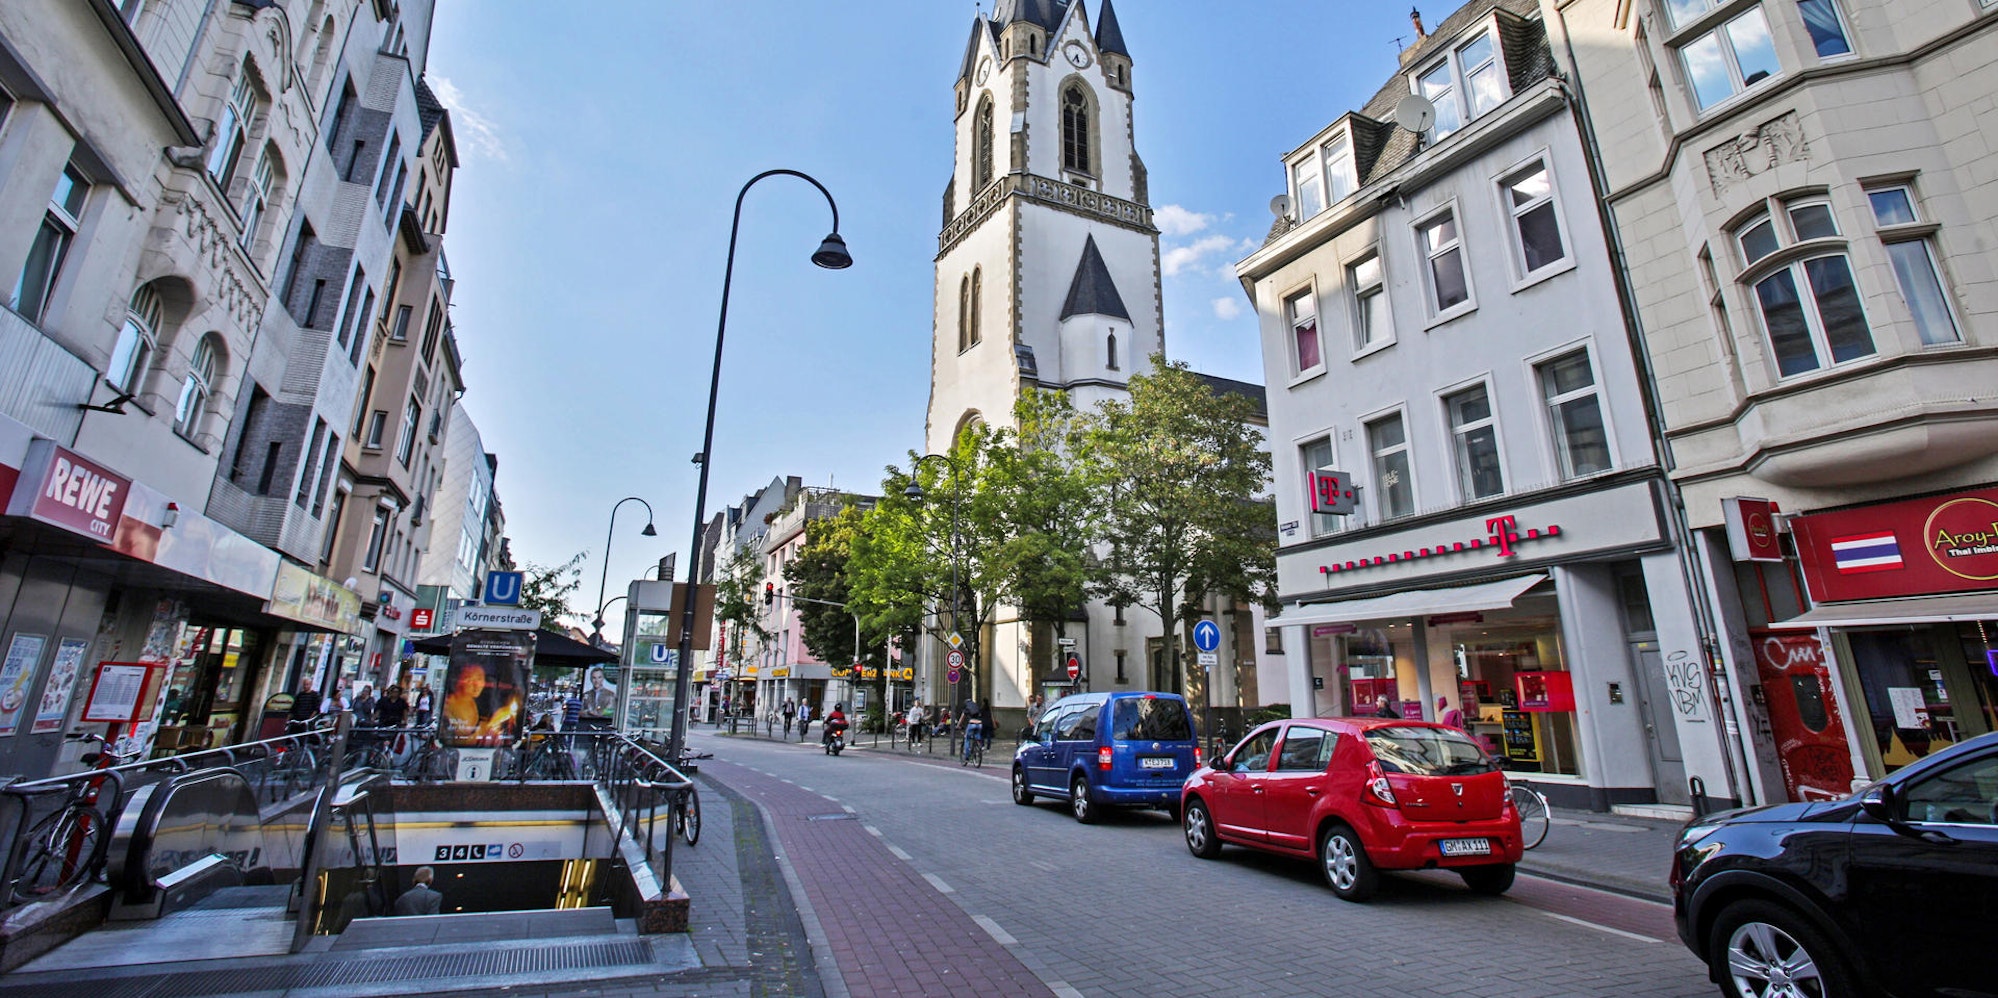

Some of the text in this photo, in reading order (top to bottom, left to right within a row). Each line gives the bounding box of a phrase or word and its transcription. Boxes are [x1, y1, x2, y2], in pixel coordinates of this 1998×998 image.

[46, 457, 117, 520] REWE
[89, 518, 111, 536] CITY
[1949, 548, 1971, 557] Thai
[492, 575, 516, 600] U
[464, 611, 533, 624] Körnerstraße
[652, 644, 668, 662] U
[950, 654, 961, 665] 30
[1473, 840, 1489, 850] 111
[439, 848, 465, 858] 3 4
